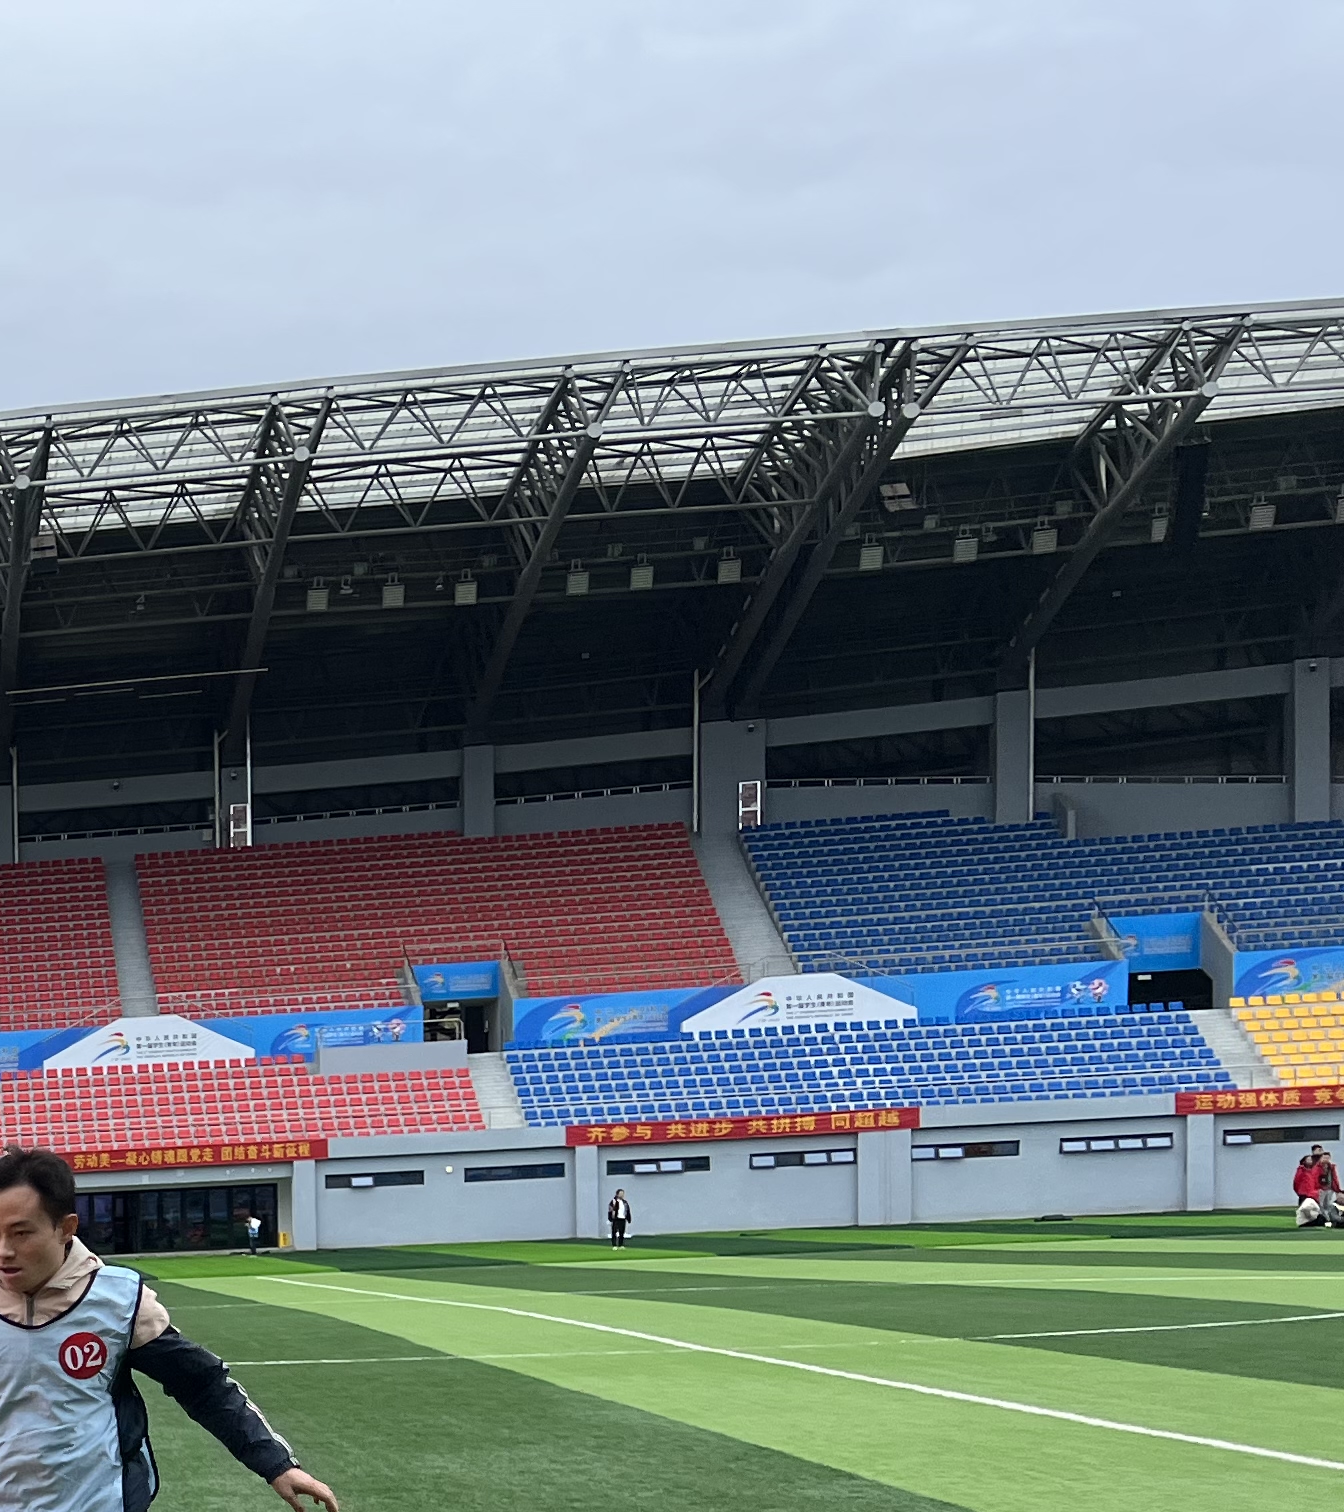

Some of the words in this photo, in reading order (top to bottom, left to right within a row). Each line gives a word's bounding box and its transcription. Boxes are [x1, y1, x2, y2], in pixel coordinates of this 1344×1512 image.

[1194, 1088, 1302, 1110] 运动强体质
[587, 1125, 653, 1142] 齐参与
[666, 1120, 735, 1138] 共进步
[747, 1115, 817, 1134] 共拼搏
[831, 1110, 900, 1129] 同超越
[221, 1142, 310, 1161] 团结奋斗新征程
[64, 1341, 103, 1371] 02
